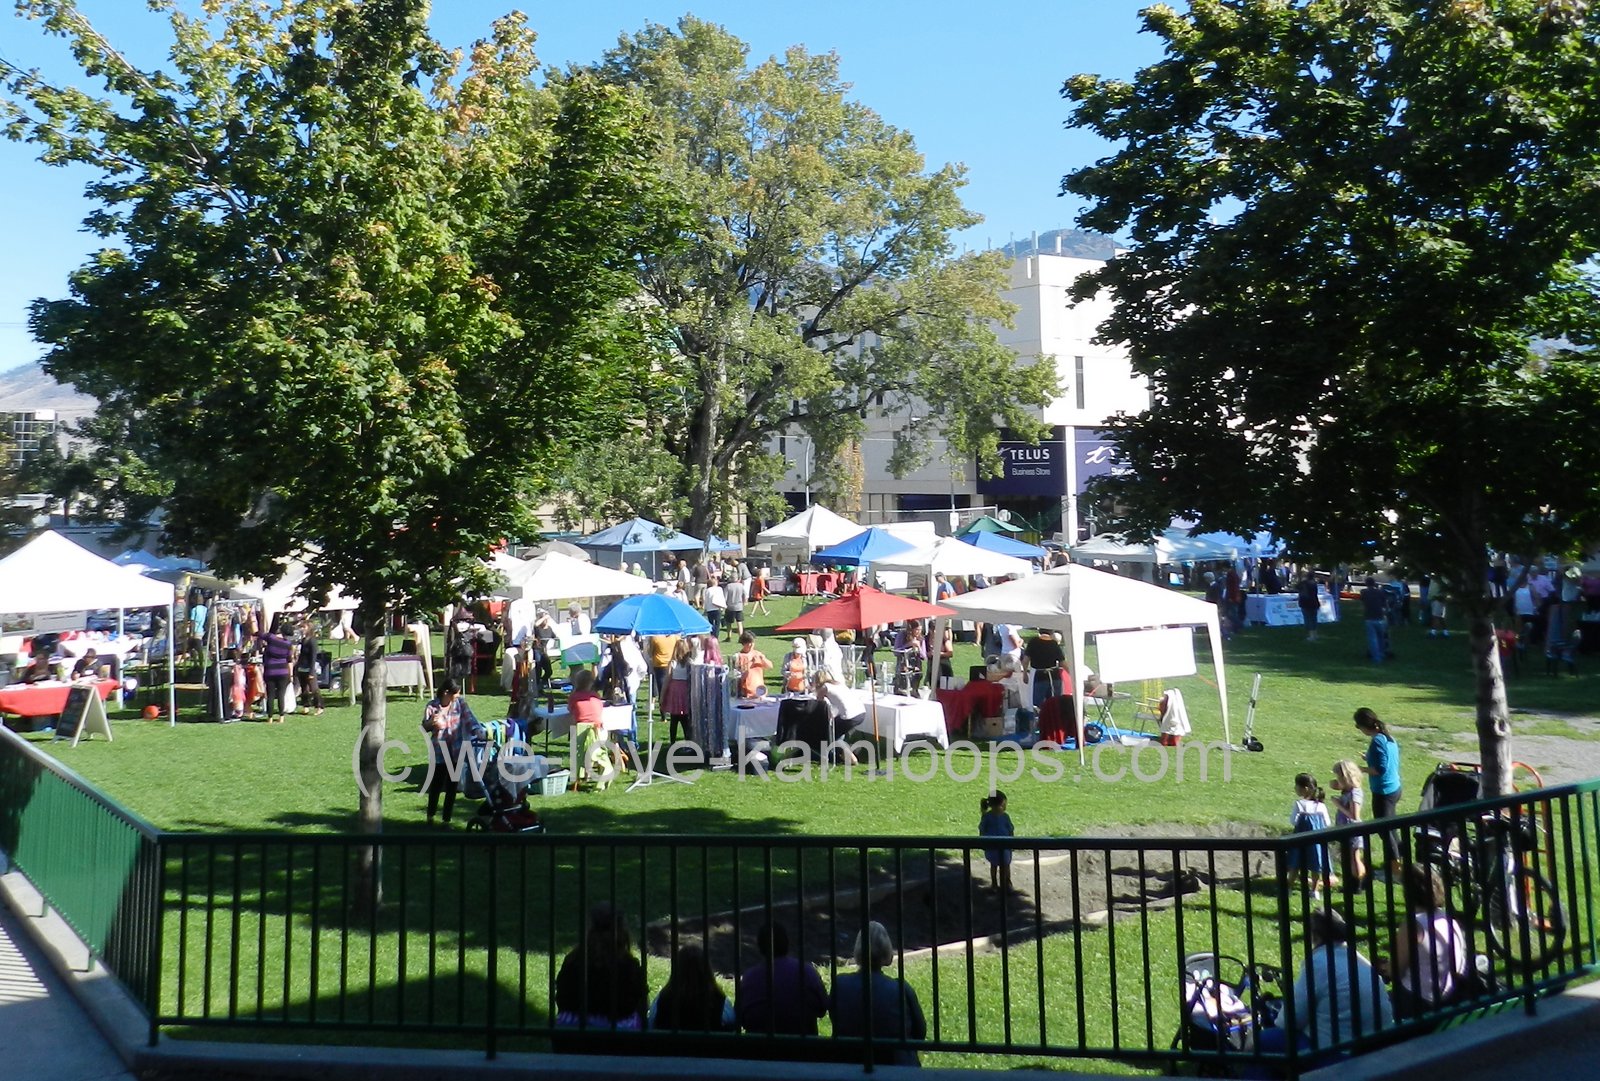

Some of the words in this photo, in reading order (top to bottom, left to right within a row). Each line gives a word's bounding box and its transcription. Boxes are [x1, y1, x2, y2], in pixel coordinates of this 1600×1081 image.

[1010, 448, 1050, 460] TELUS
[1012, 467, 1035, 476] Business
[1036, 467, 1051, 476] Store
